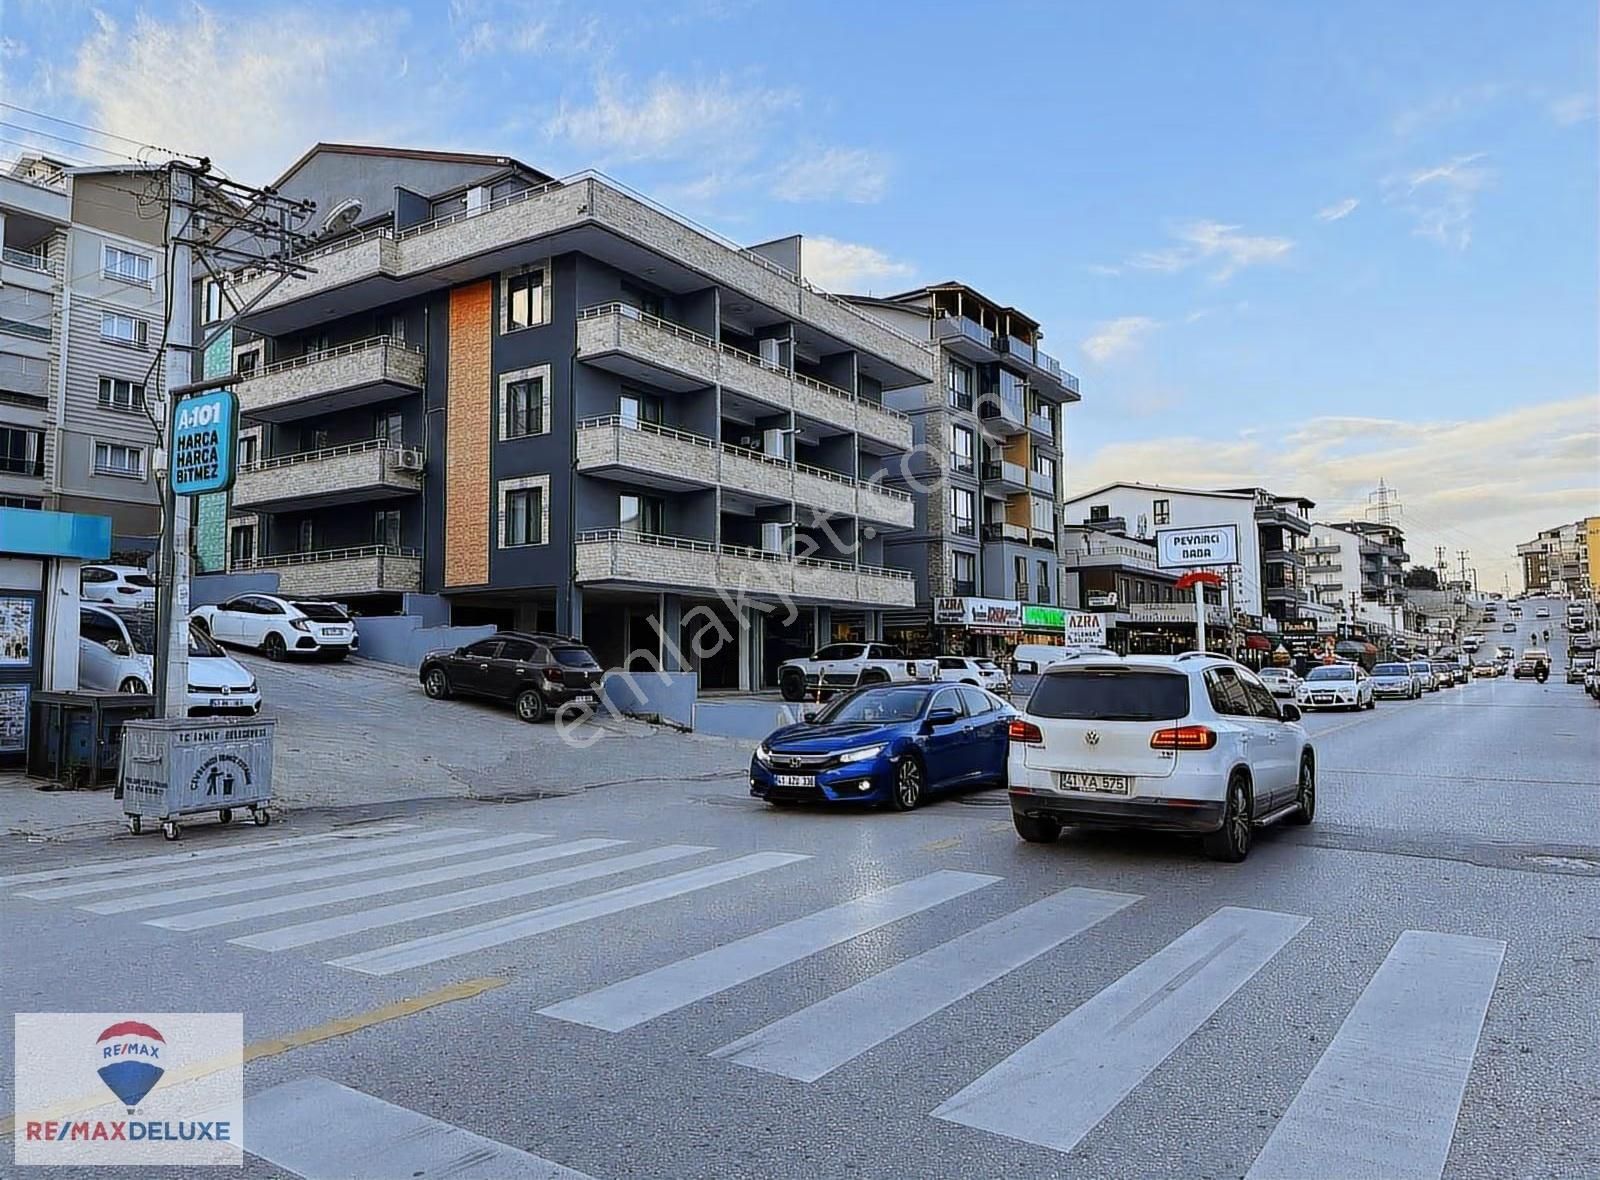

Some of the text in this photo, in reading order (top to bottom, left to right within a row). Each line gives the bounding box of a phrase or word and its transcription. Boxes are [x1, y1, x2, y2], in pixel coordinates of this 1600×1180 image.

[178, 430, 218, 451] HARCA
[177, 447, 218, 468] HARCA
[1069, 615, 1100, 628] AZRA
[1064, 773, 1124, 789] 41 YA 575
